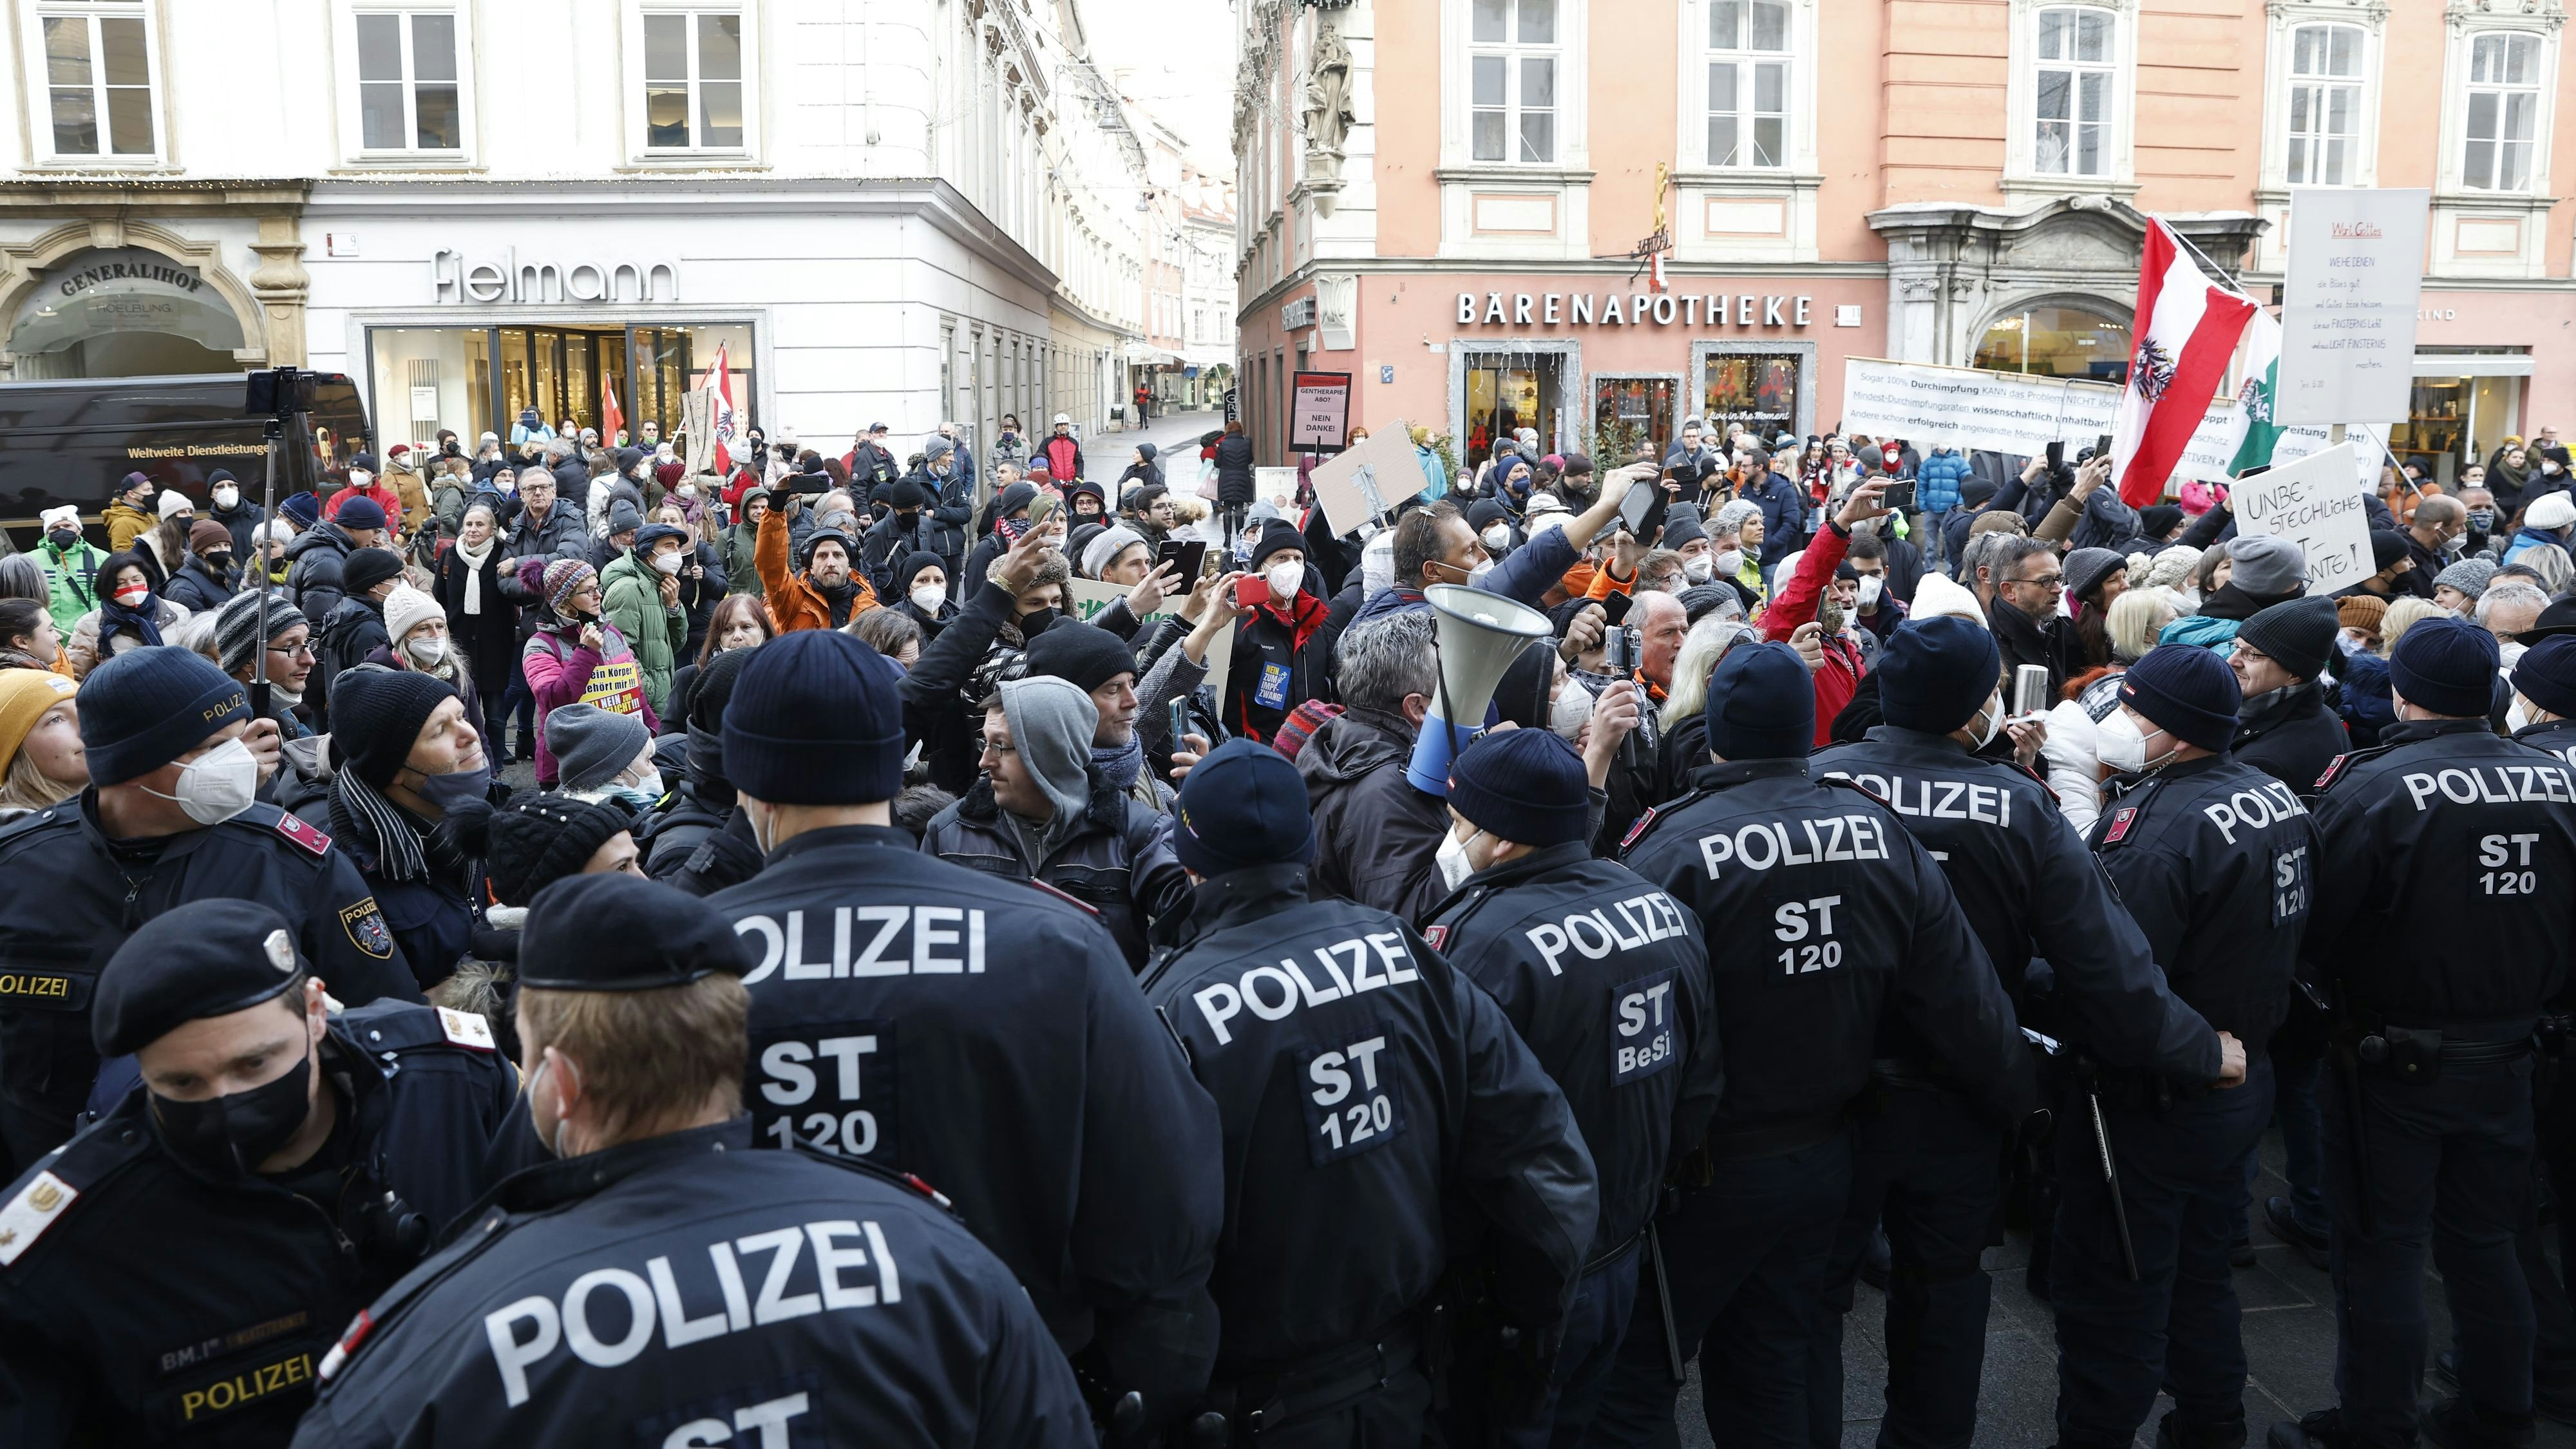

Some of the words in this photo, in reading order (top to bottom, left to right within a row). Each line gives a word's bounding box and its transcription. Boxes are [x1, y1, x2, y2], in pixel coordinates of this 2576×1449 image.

[350, 234, 356, 247] 9
[61, 263, 202, 297] GENERALIHOF
[431, 245, 679, 303] fielmann
[1456, 292, 1813, 326] BÄRENAPOTHEKE
[1860, 372, 1884, 384] Sogar
[1887, 375, 1908, 387] 100%
[1911, 380, 1979, 395] Durchimpfung
[1982, 386, 2007, 396] KANN
[2009, 390, 2025, 399] das
[2027, 392, 2063, 402] Problem
[2066, 395, 2096, 406] NICHT
[1739, 410, 1754, 420] the
[1754, 412, 1790, 420] Moment
[1850, 410, 1879, 420] Andere
[1882, 412, 1905, 422] schon
[1908, 417, 1958, 430] erfolgreich
[1961, 423, 2012, 437] angewandte
[1853, 391, 1969, 412] Mindest-Durchimpfungsraten
[1973, 406, 2052, 422] wissenschaftlich
[128, 446, 185, 459] Weltweite
[587, 682, 612, 693] ehört
[614, 680, 627, 689] mir
[591, 670, 605, 679] ein
[608, 667, 632, 677] Körper
[1261, 681, 1279, 692] IMPF-
[1263, 672, 1278, 683] ZUM
[1265, 665, 1280, 676] NEIN
[203, 692, 245, 724] POLIZE
[600, 694, 621, 708] NEIN
[622, 693, 632, 702] ZUR
[1258, 688, 1283, 703] ZWANG!
[1824, 772, 2011, 828] OLIZEI
[2401, 766, 2576, 811] POLIZEI
[2203, 779, 2311, 845] POLIZ
[1698, 815, 1889, 880] POLIZEI
[2478, 833, 2540, 867] ST
[2277, 846, 2307, 889] ST
[2479, 871, 2537, 895] 120
[345, 902, 378, 923] POLIZE
[2277, 885, 2305, 918] 120
[1526, 892, 1688, 977] POLIZEI
[1774, 895, 1841, 943] ST
[735, 905, 985, 985] OLIZEI
[1778, 940, 1842, 975] 120
[0, 975, 68, 997] OLIZEI
[1617, 980, 1672, 1037] ST
[1617, 1031, 1671, 1074] BeSi
[761, 1035, 878, 1106] ST
[1309, 1036, 1385, 1106] ST
[767, 1110, 878, 1155] 120
[1320, 1095, 1392, 1151] 120
[484, 1220, 902, 1409] POLIZEI
[182, 1353, 314, 1421] POLIZEI
